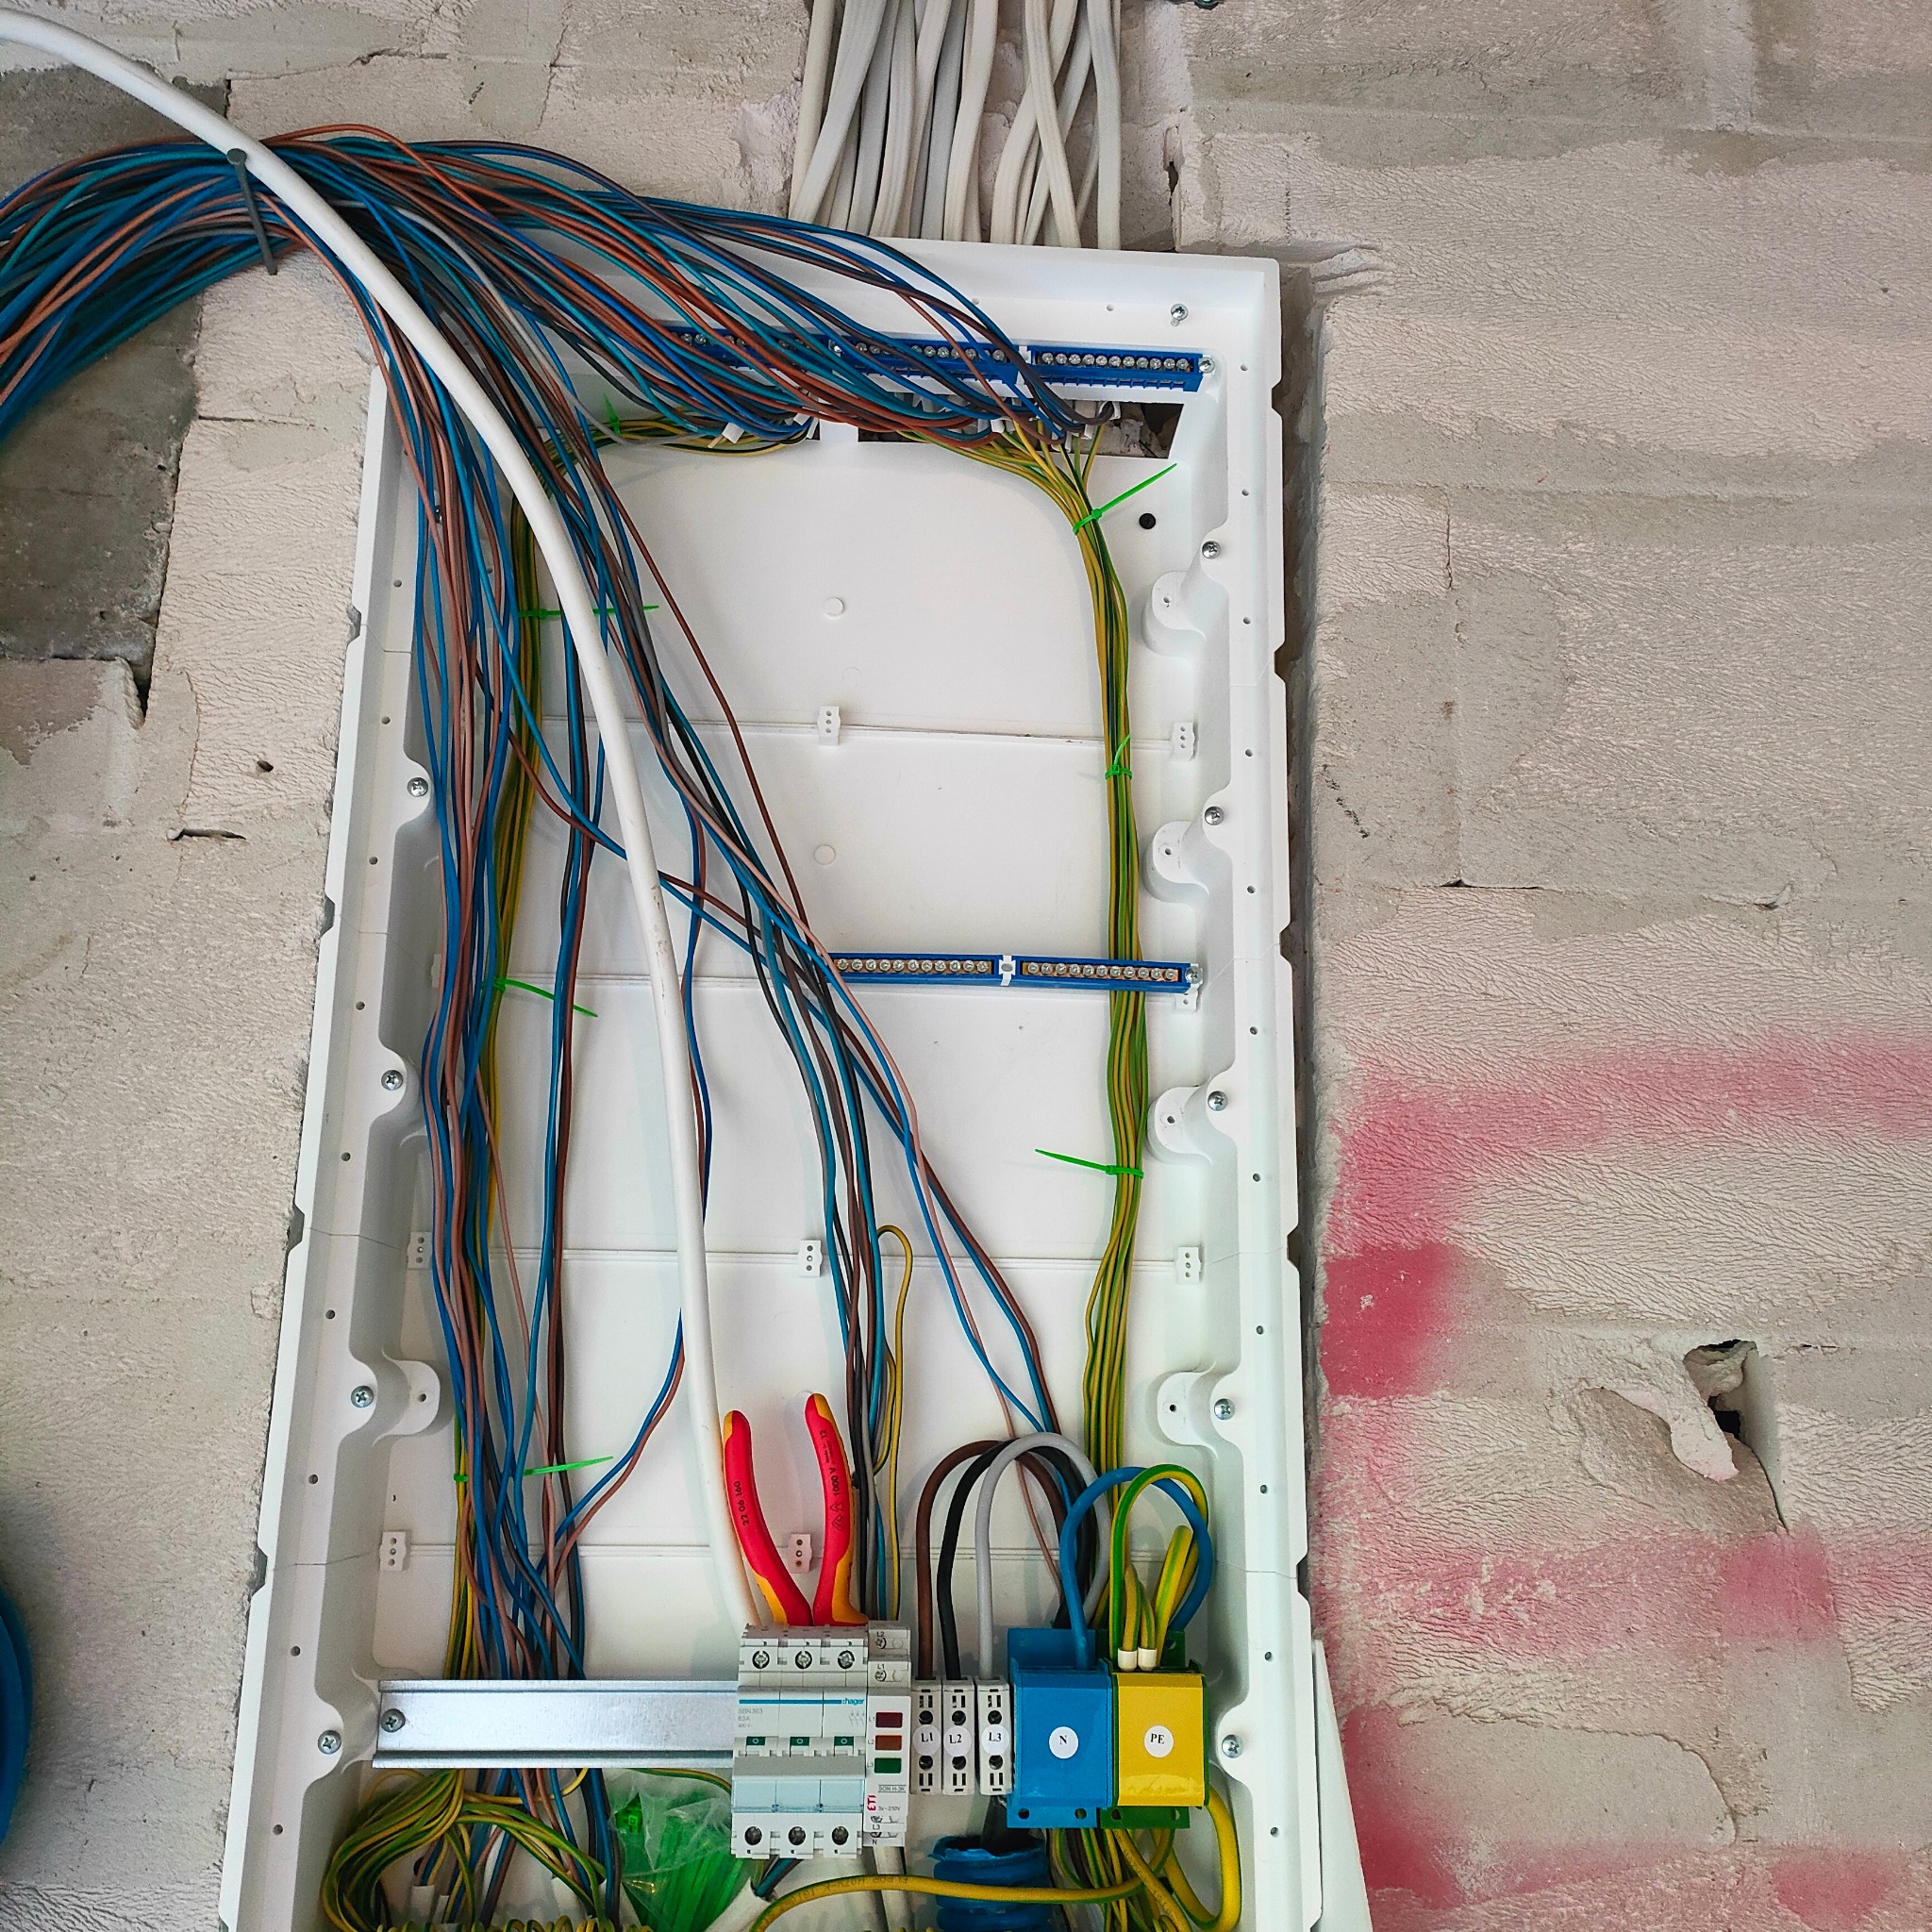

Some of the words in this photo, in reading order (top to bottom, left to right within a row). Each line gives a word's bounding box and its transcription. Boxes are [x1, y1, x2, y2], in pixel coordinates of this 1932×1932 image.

[734, 1481, 742, 1496] 160
[831, 1475, 841, 1497] 1000
[738, 1500, 745, 1512] 06
[741, 1514, 749, 1525] 22
[922, 1732, 934, 1742] L1
[949, 1734, 962, 1744] L2
[989, 1732, 1002, 1742] L3
[1058, 1735, 1067, 1745] N
[1150, 1733, 1165, 1744] PE
[867, 1794, 877, 1811] ETI
